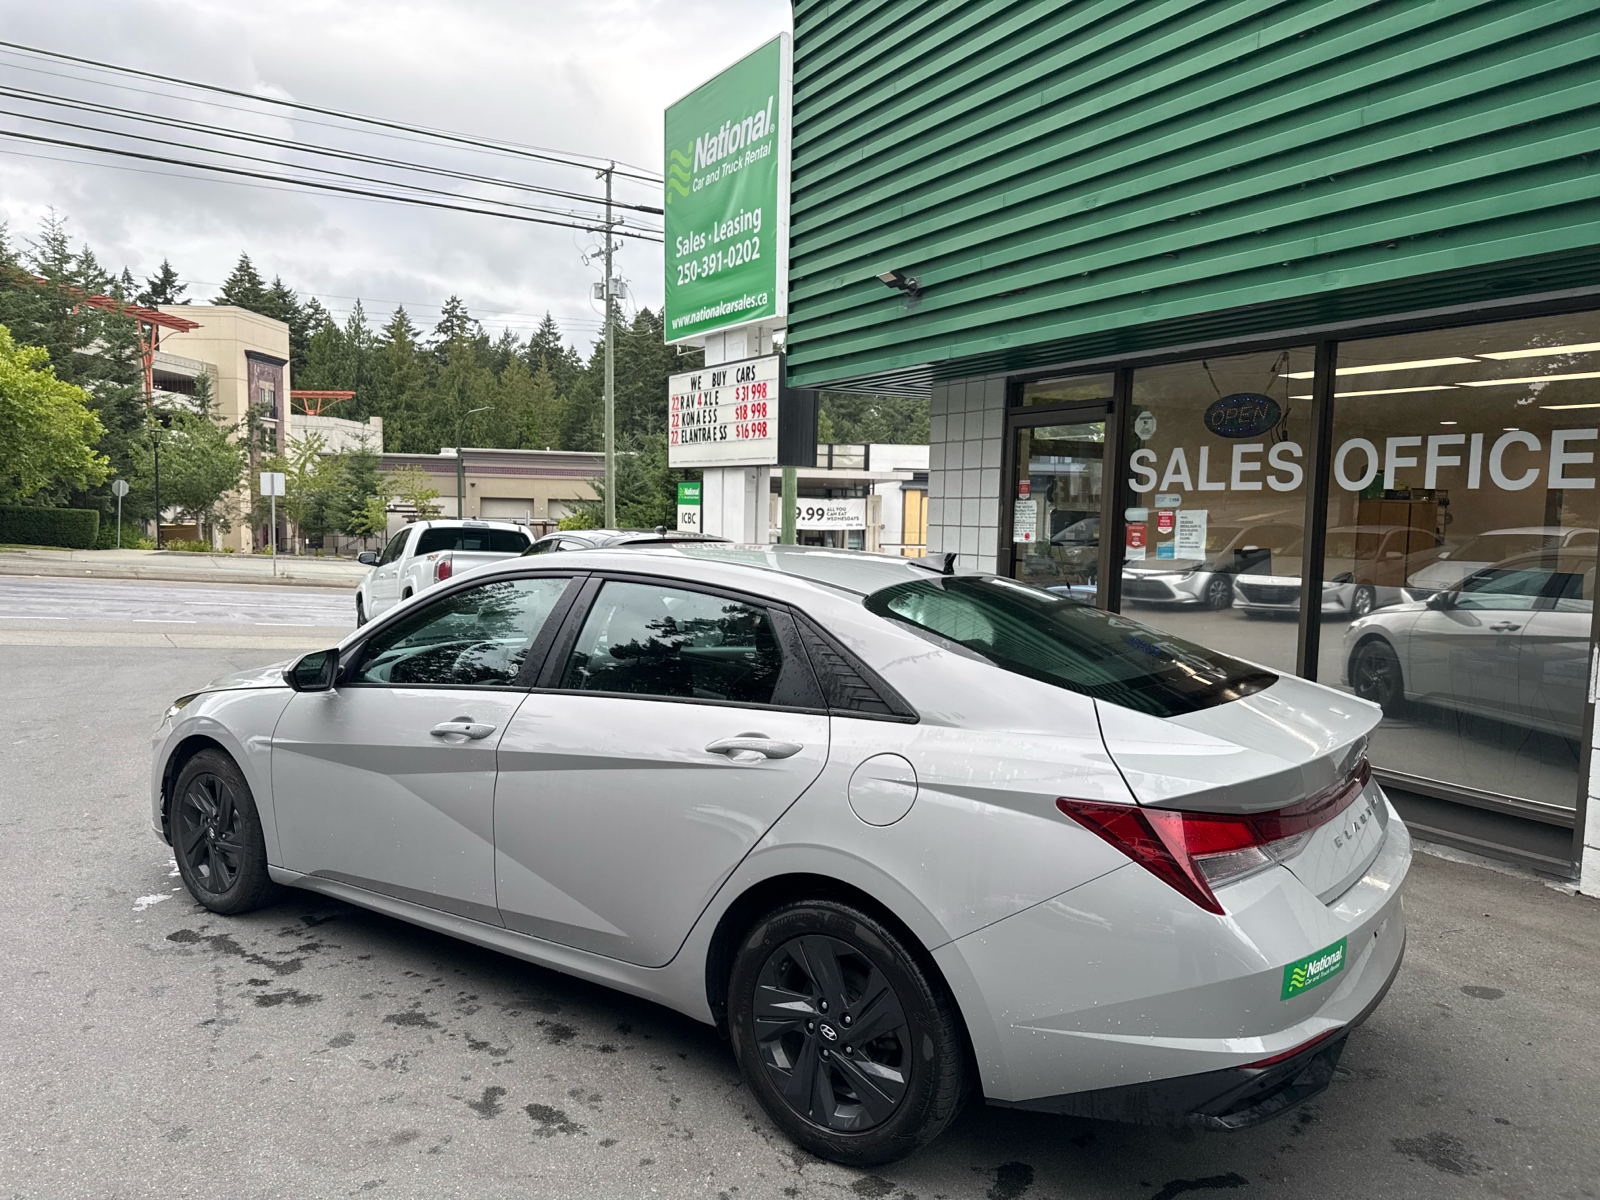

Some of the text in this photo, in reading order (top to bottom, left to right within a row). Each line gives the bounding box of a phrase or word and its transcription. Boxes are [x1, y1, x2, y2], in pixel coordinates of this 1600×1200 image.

[694, 95, 774, 173] National
[693, 140, 771, 192] Car and Truck Rental
[676, 207, 762, 258] Sales Leasing
[677, 236, 760, 286] 250-391-0202
[671, 292, 768, 329] www.nationalcarsales.ca
[690, 365, 756, 391] WE BUY CARS
[671, 395, 680, 411] 22
[1211, 403, 1269, 425] OPEN
[671, 413, 680, 427] 22
[670, 430, 679, 444] 22
[1128, 428, 1599, 493] SALES OFFICE
[681, 512, 696, 525] ICBC
[1306, 945, 1343, 978] National
